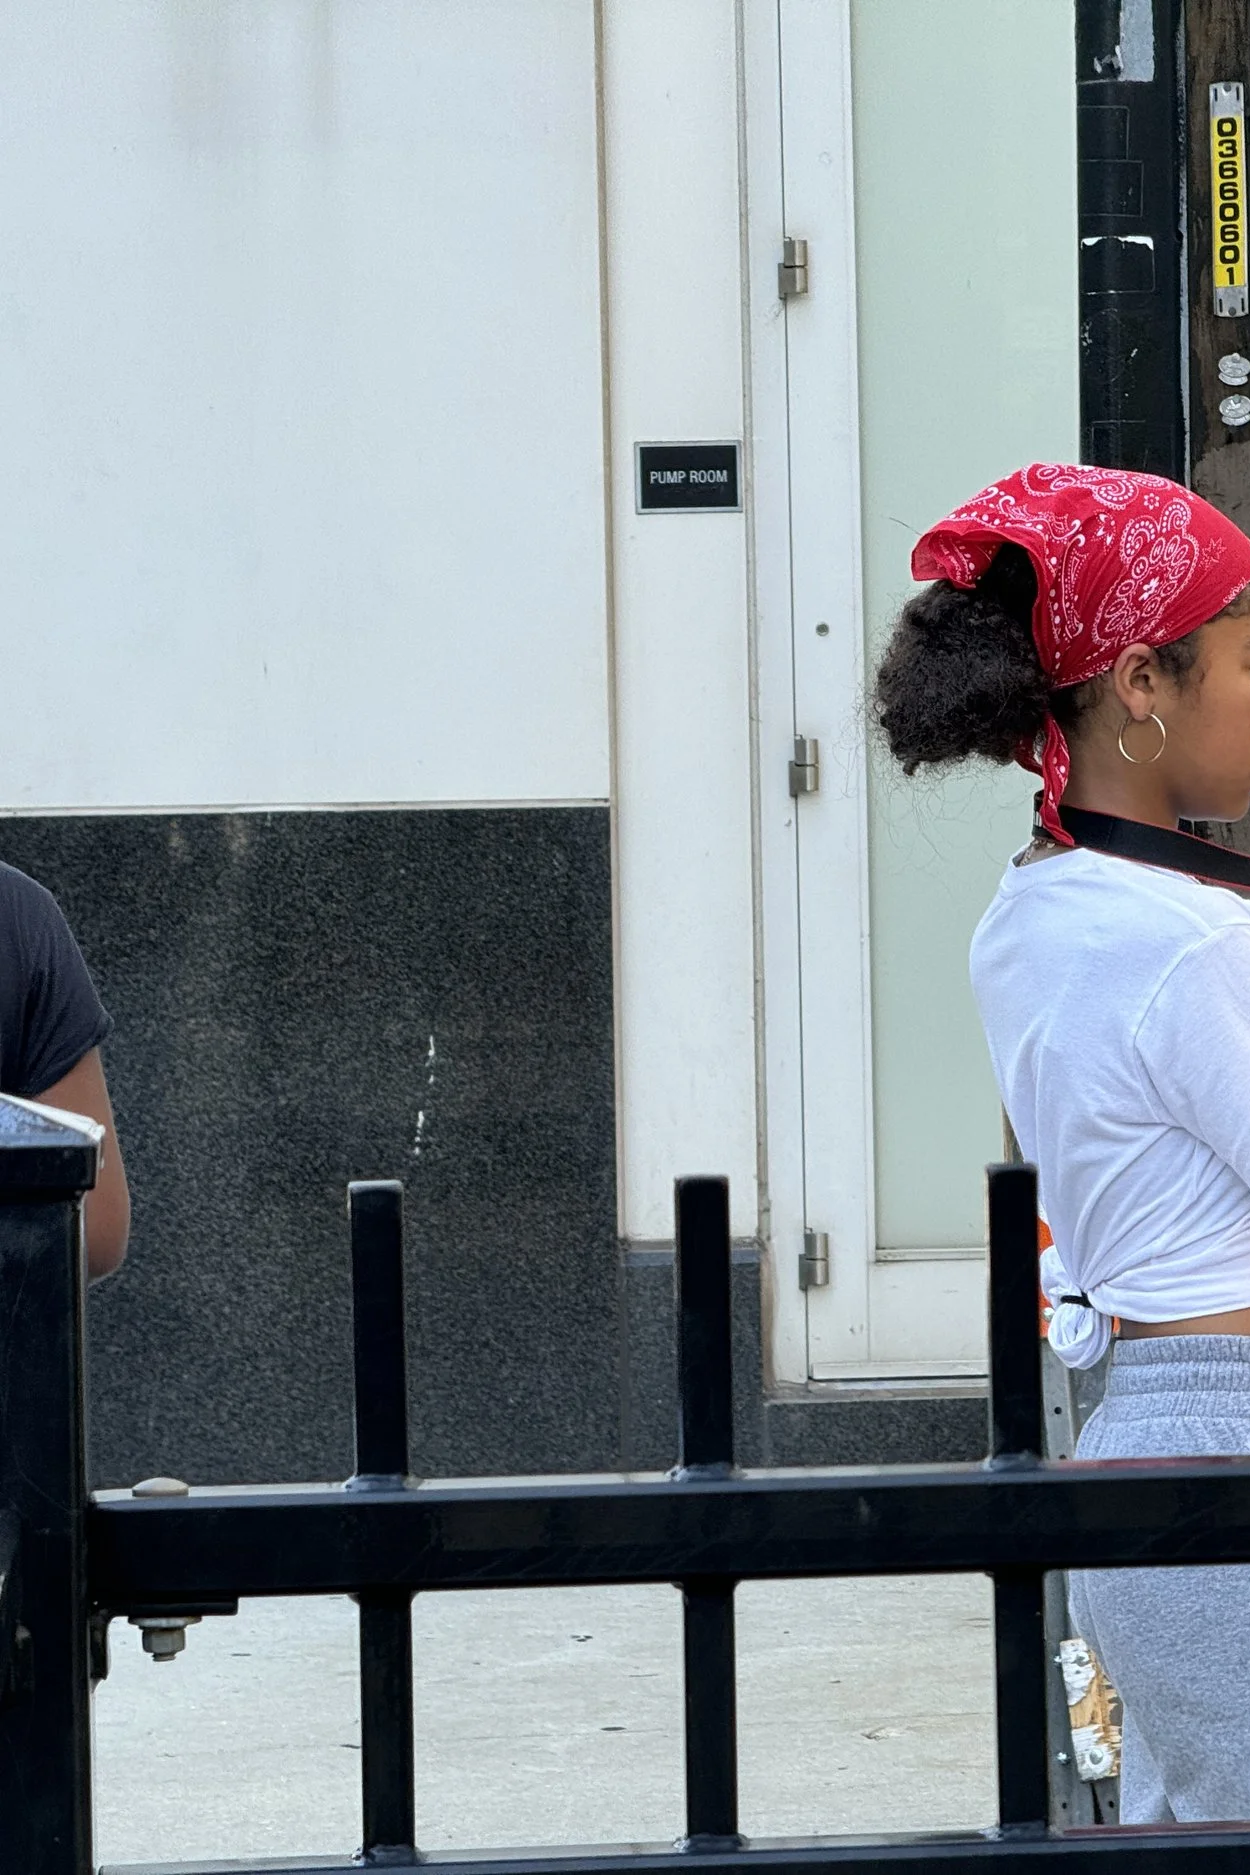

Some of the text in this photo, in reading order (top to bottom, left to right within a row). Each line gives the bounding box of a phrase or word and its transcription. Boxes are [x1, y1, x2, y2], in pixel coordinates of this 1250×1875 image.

[1217, 117, 1240, 285] 03660601
[649, 470, 728, 484] PUMP ROOM
